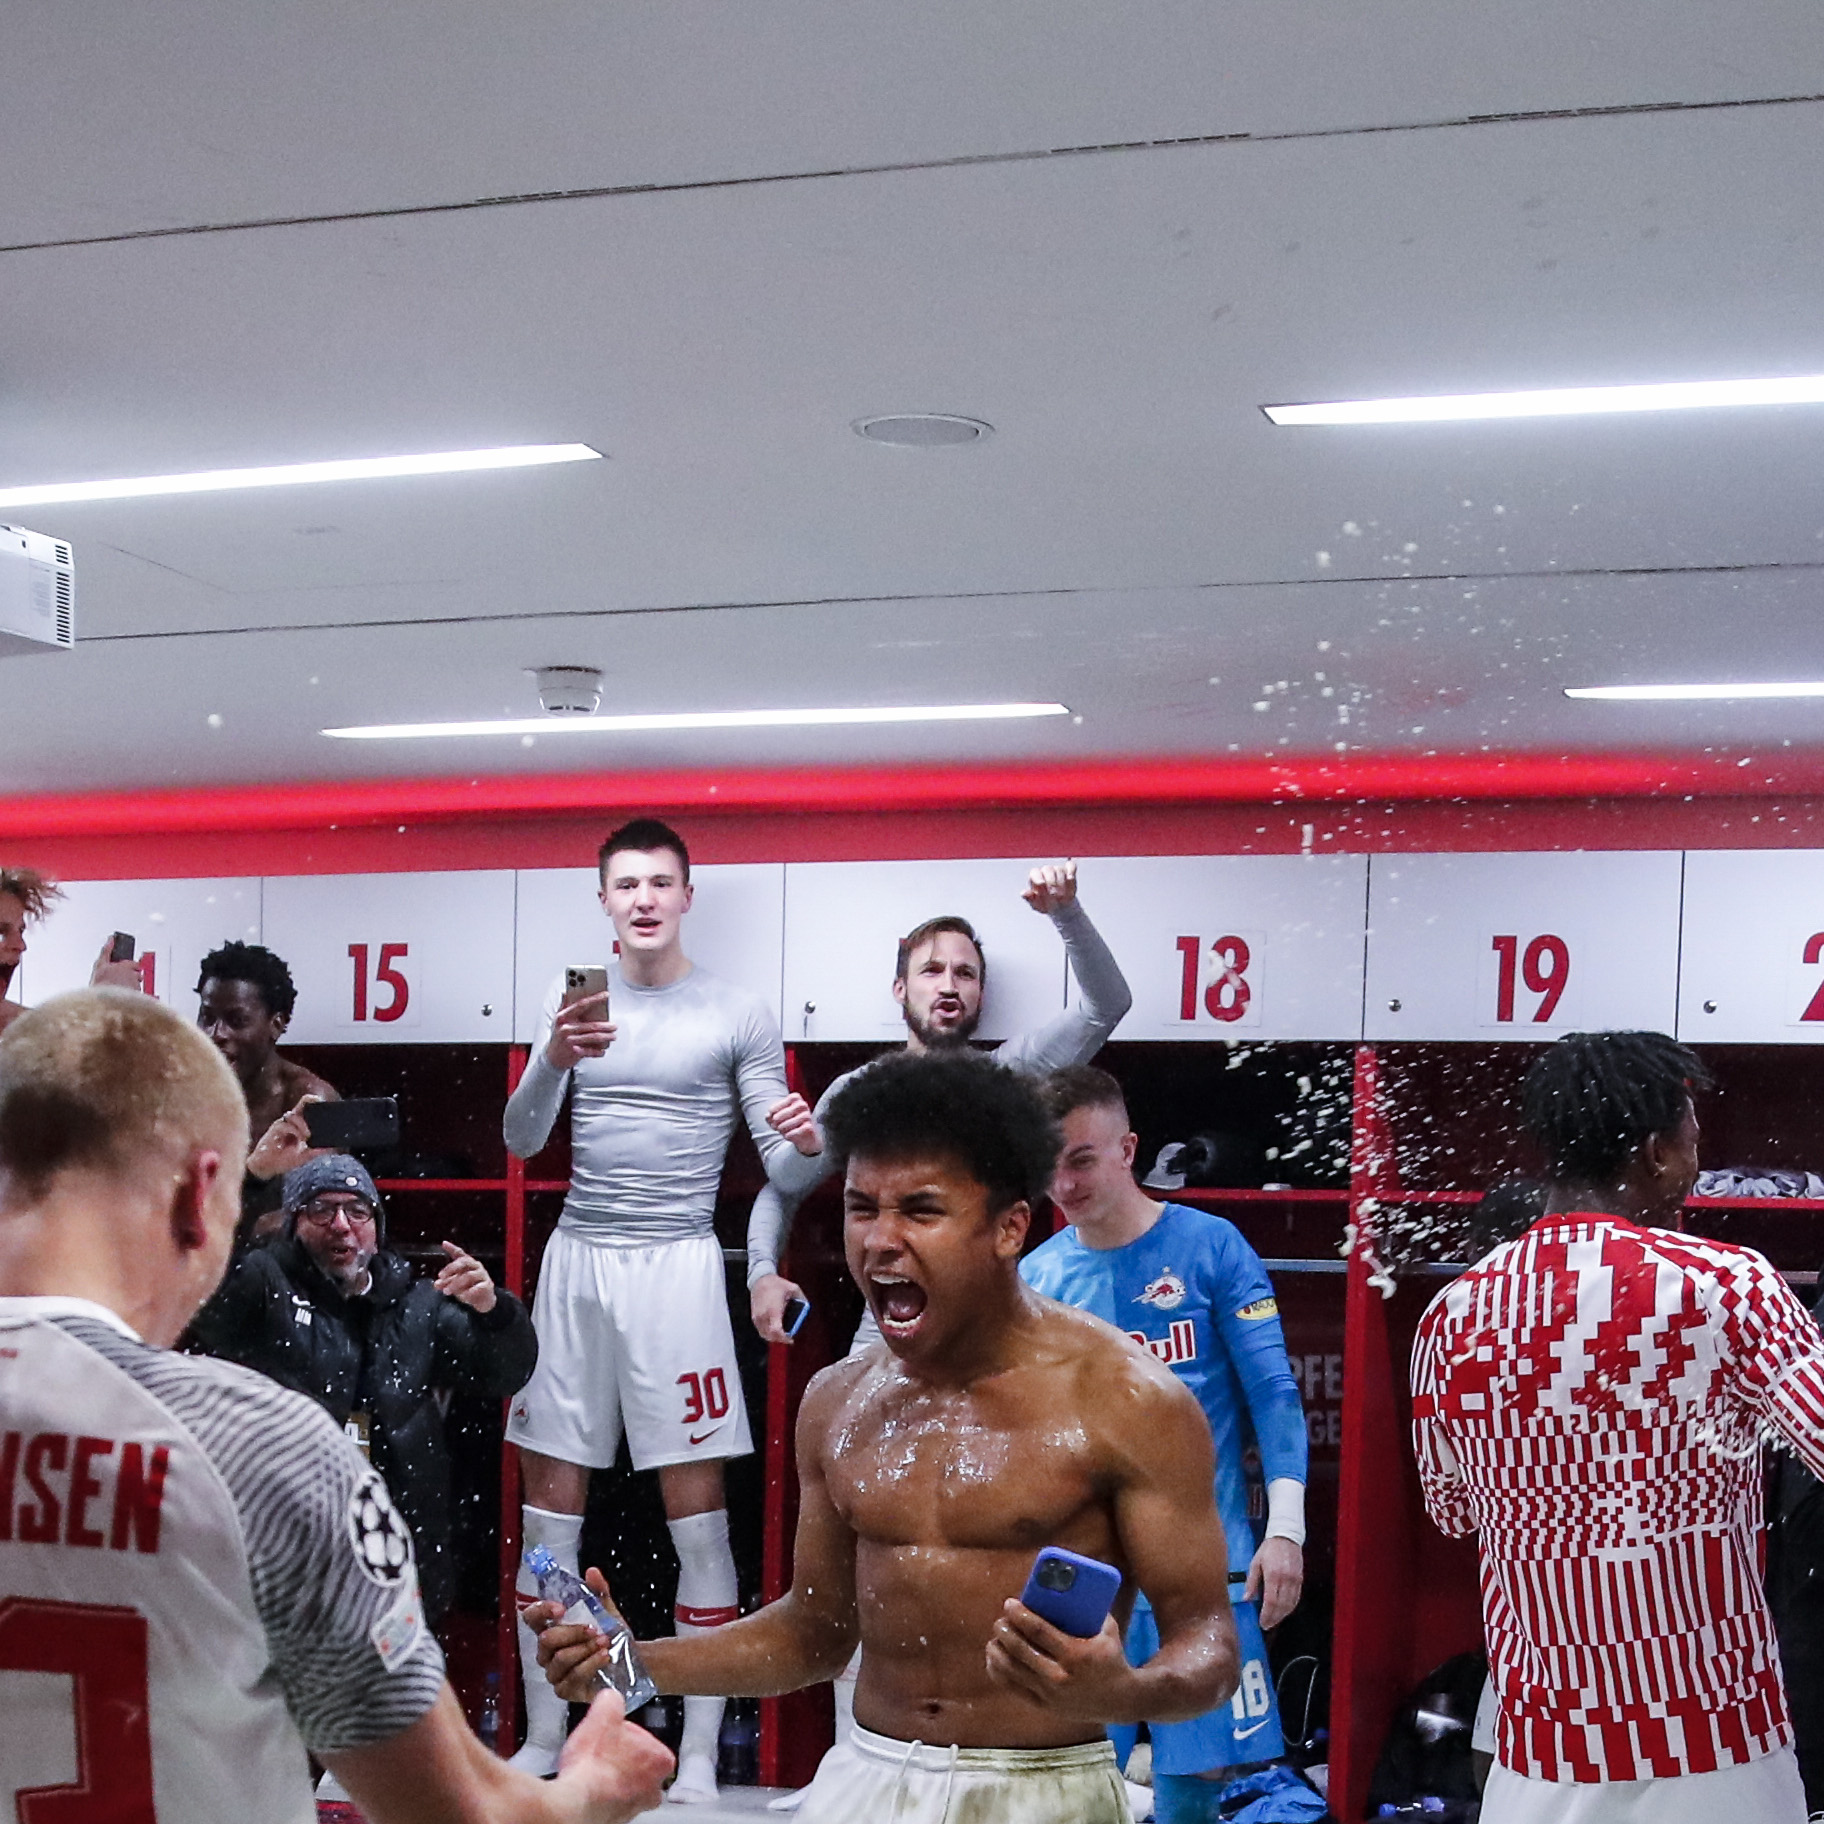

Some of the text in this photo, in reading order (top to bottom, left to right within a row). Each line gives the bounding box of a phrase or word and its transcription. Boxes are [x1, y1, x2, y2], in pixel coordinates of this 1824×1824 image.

[347, 942, 410, 1022] 15
[1176, 935, 1252, 1023] 18
[1491, 933, 1570, 1023] 19
[675, 1367, 729, 1424] 30
